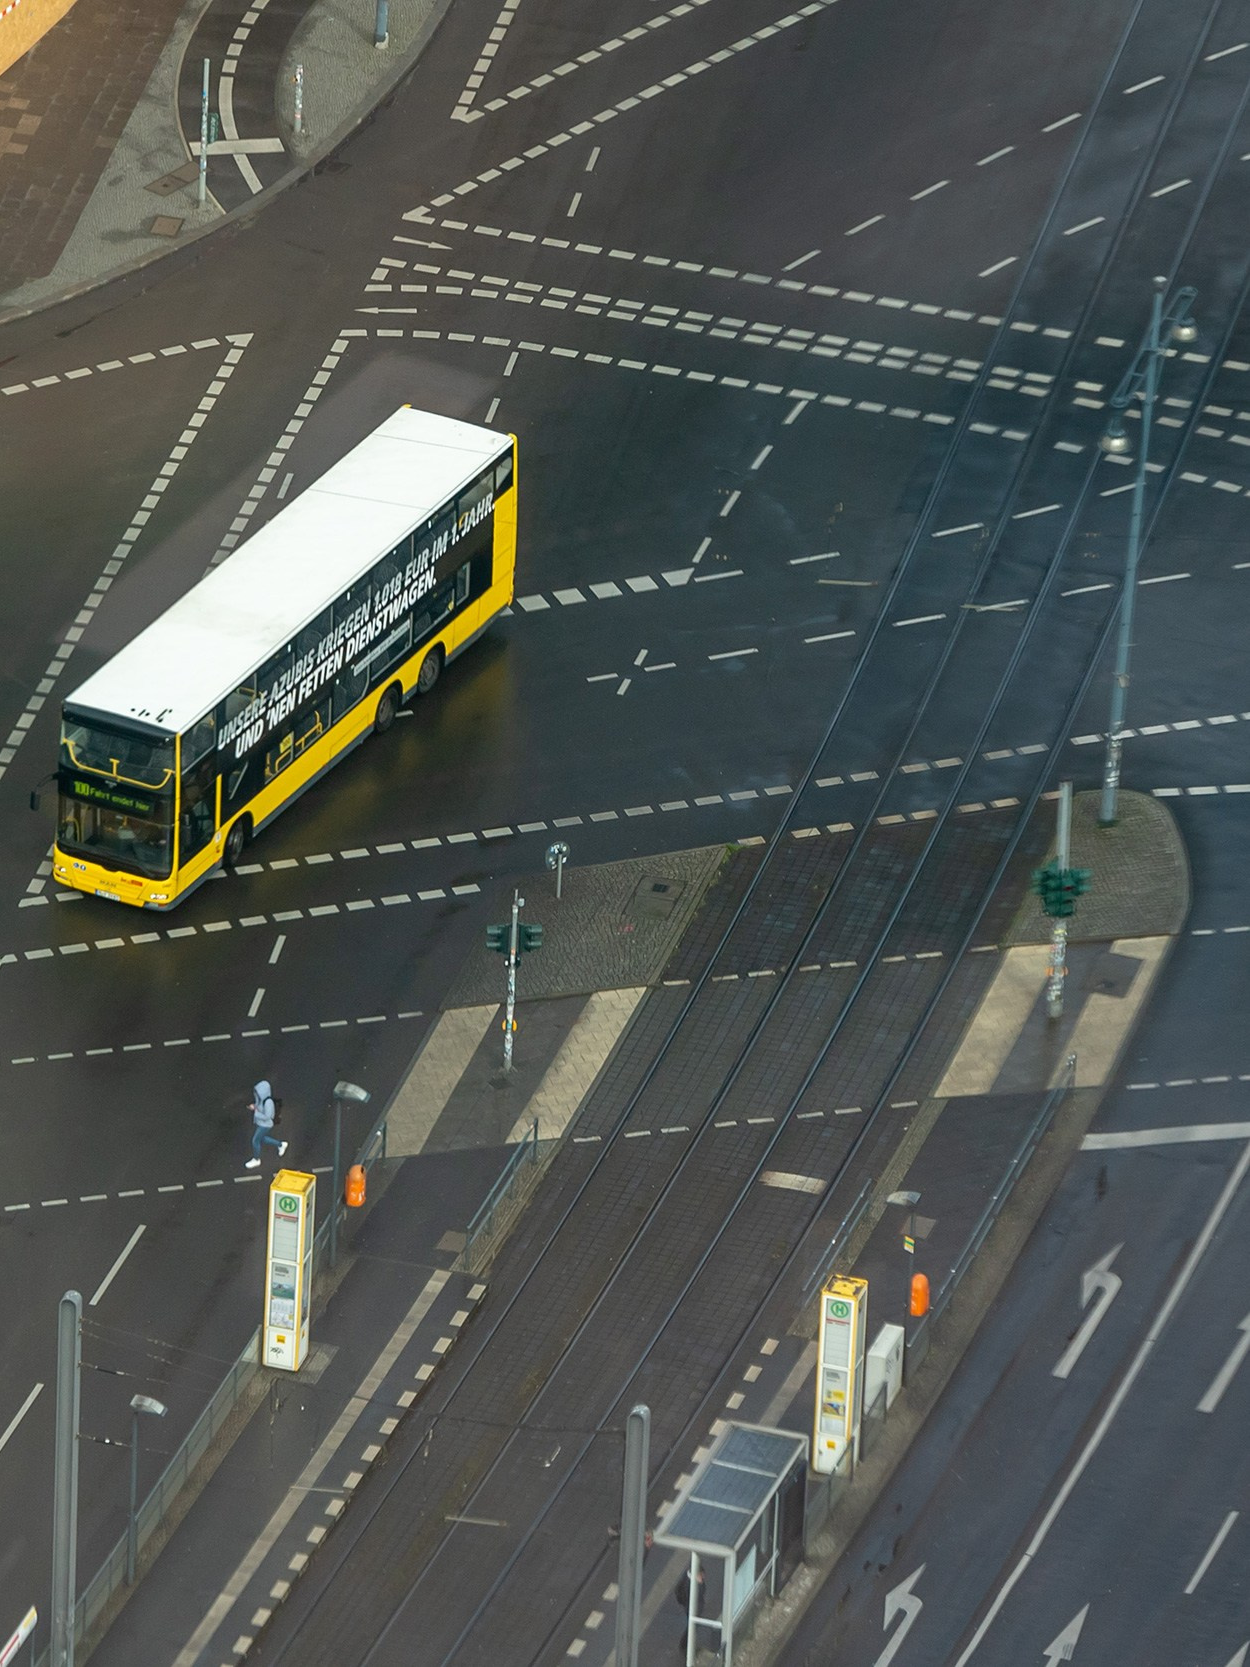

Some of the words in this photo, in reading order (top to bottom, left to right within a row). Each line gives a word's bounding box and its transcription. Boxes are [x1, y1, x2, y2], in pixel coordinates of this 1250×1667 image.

[218, 690, 268, 750] UNSERE
[268, 648, 315, 707] AZUBIS
[317, 598, 371, 665] KRIEGEN
[374, 572, 402, 613] 1.018
[404, 548, 429, 587] EUR
[431, 530, 448, 563] IM
[451, 523, 459, 545] 1.
[461, 493, 495, 537] JAHR.
[235, 718, 263, 759] UND
[266, 689, 297, 730] 'NEN
[298, 646, 344, 704] FETTEN
[345, 566, 437, 663] DIENSTWAGEN.
[74, 781, 90, 796] 100
